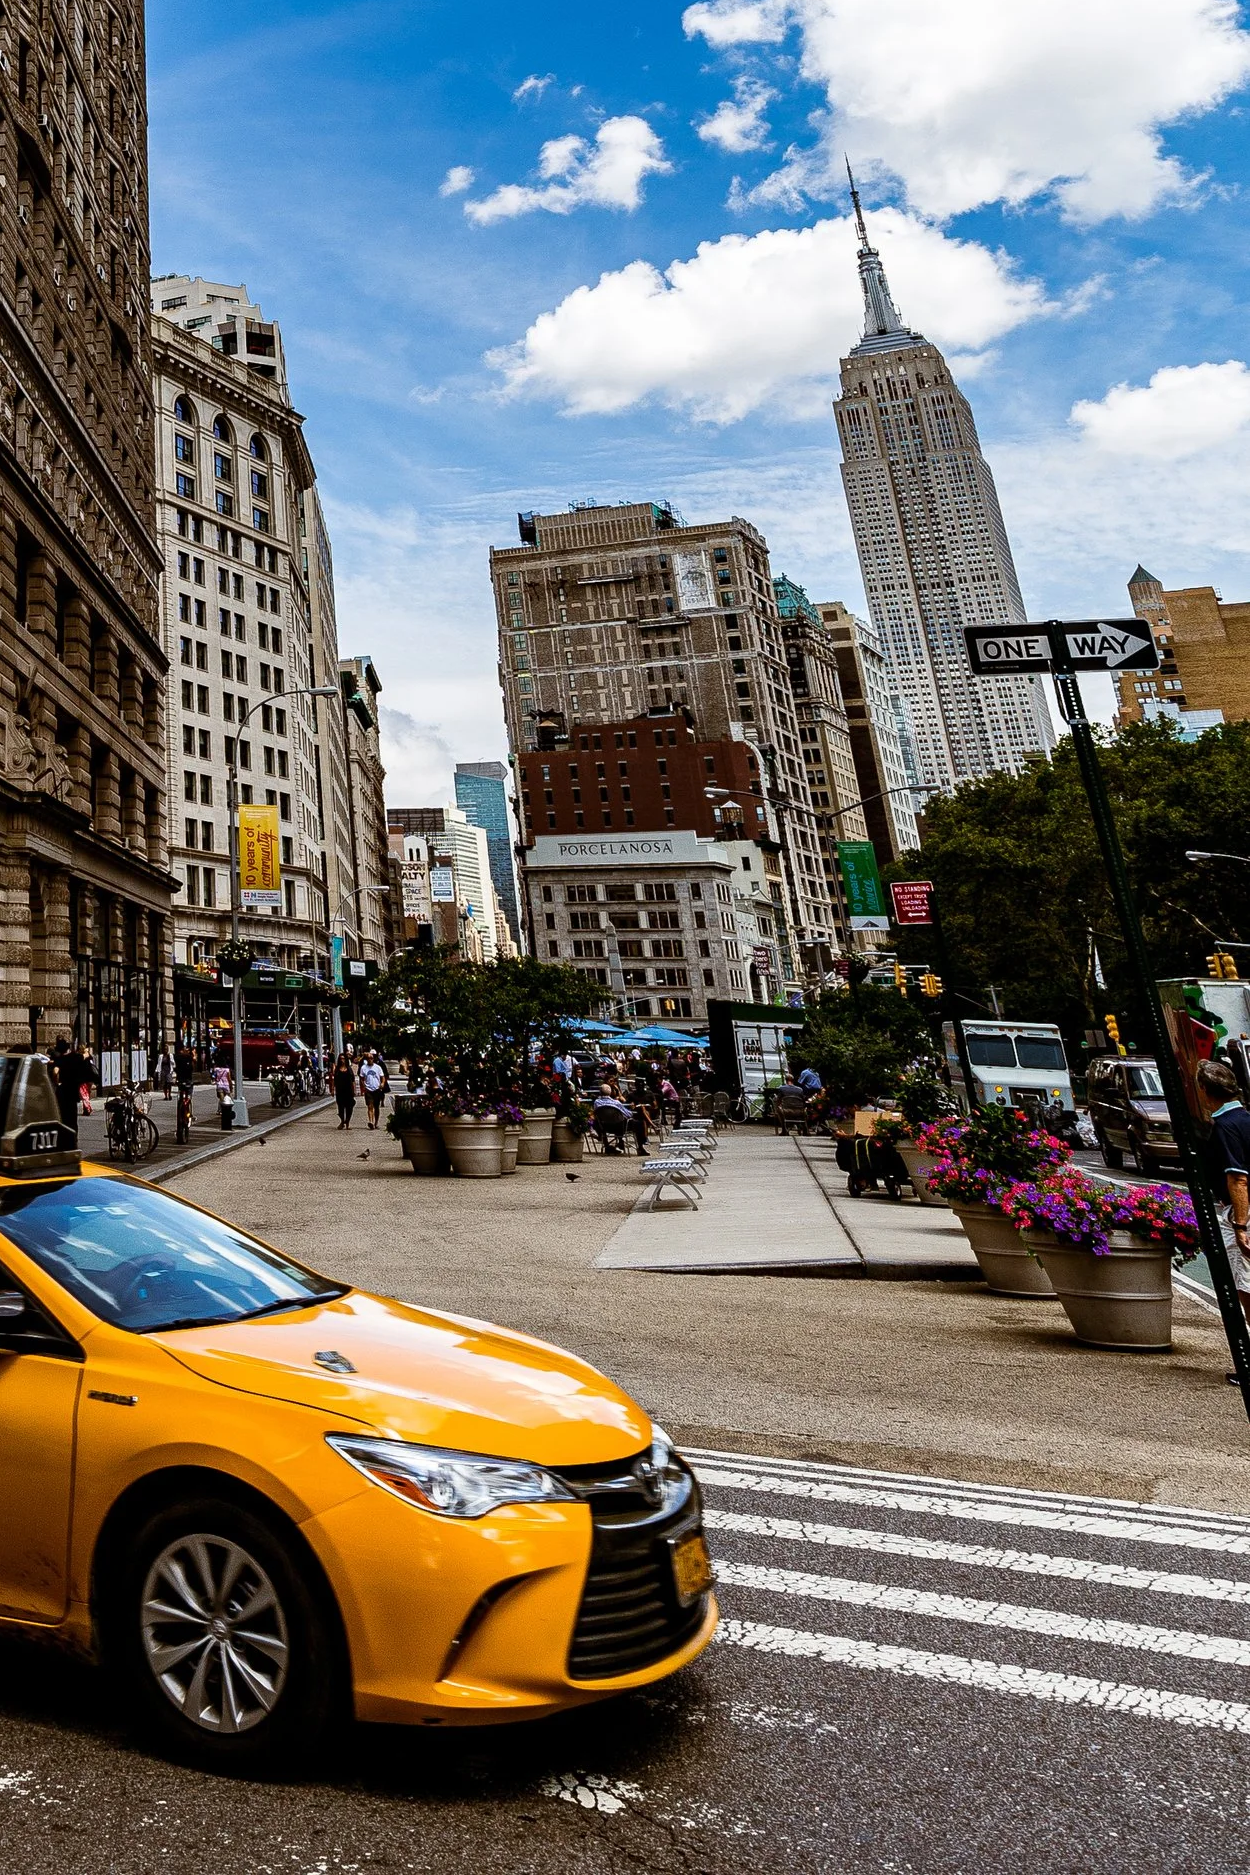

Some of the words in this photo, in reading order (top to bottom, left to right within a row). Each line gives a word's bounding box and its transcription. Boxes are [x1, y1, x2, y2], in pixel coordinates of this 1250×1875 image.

[983, 639, 1043, 659] ONE
[1073, 635, 1130, 656] WAY
[244, 827, 254, 838] of
[560, 842, 672, 856] PORCELANOSA
[247, 841, 258, 871] years
[257, 829, 278, 887] community
[844, 861, 855, 871] of
[246, 875, 256, 886] 10
[402, 872, 425, 880] ALTY
[849, 873, 864, 901] years
[853, 903, 862, 913] 10
